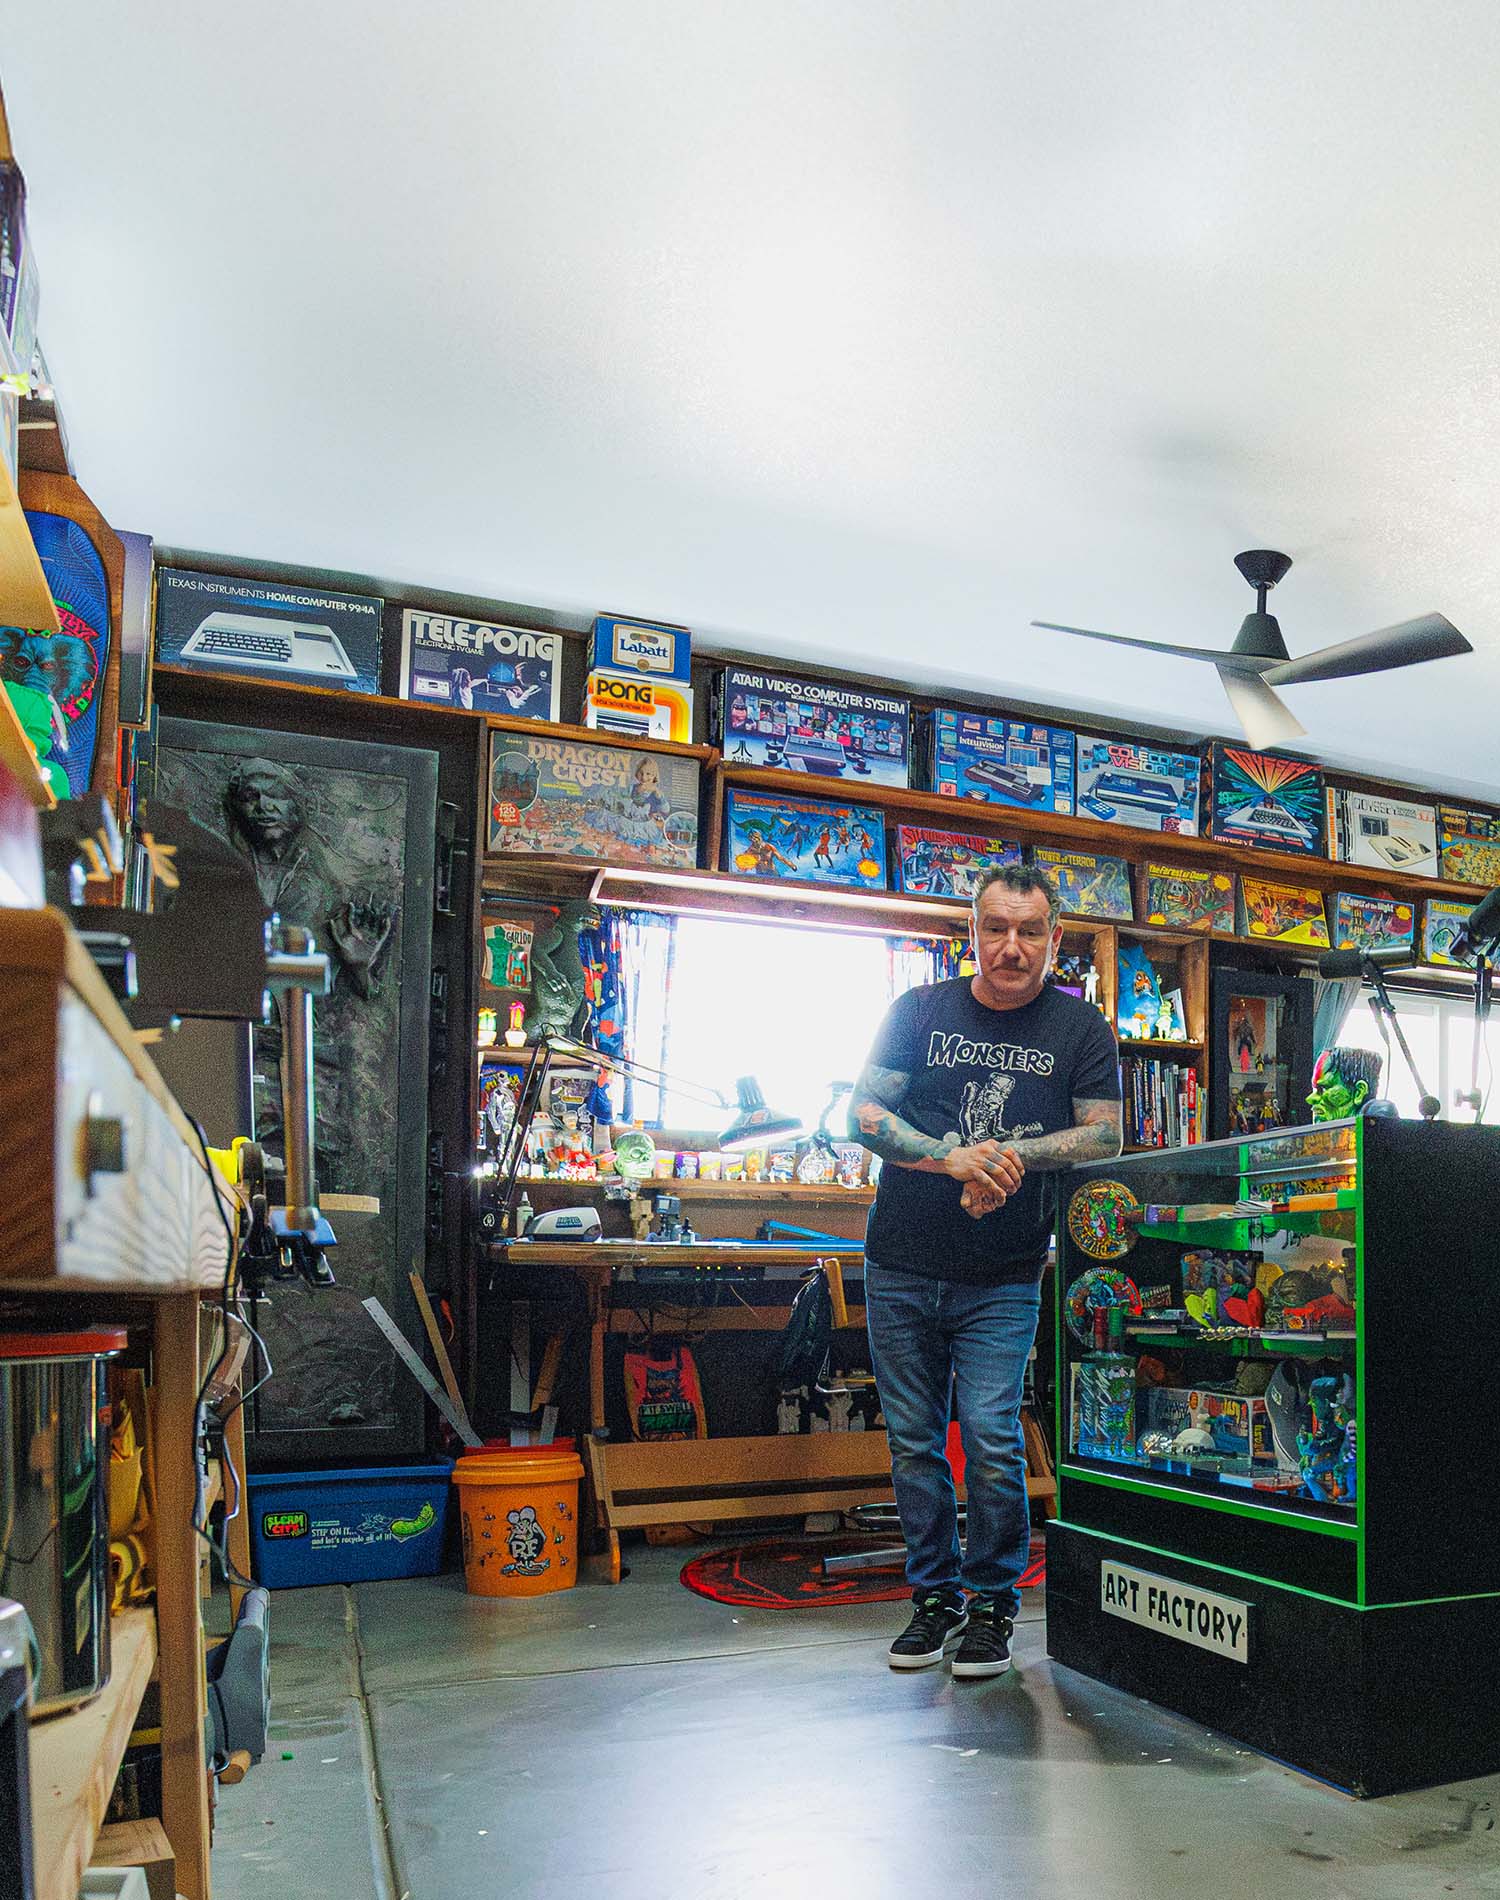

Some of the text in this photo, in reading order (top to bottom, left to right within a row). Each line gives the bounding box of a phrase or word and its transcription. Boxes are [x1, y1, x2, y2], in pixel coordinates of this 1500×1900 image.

[167, 576, 197, 590] TEXAS
[198, 581, 266, 599] INSTRUMENTS
[266, 591, 296, 604] HOME
[296, 596, 347, 612] COMPUTER
[411, 614, 553, 661] TELE-PONG
[415, 638, 457, 651] ELECTRONIC
[464, 646, 485, 657] GAME
[620, 638, 668, 659] Labatt
[597, 679, 653, 703] PONG
[731, 672, 905, 715] ATARI VIDEO COMPUTER SYSTEM
[528, 741, 632, 772] DRAGON
[1107, 744, 1171, 765] COLECO
[552, 762, 632, 788] CREST
[1069, 854, 1097, 868] TERROR
[1160, 865, 1183, 877] Forest
[926, 1030, 1054, 1076] MONSTERS
[311, 1529, 328, 1537] STEP
[330, 1528, 342, 1536] ON
[1105, 1573, 1242, 1649] ART FACTORY
